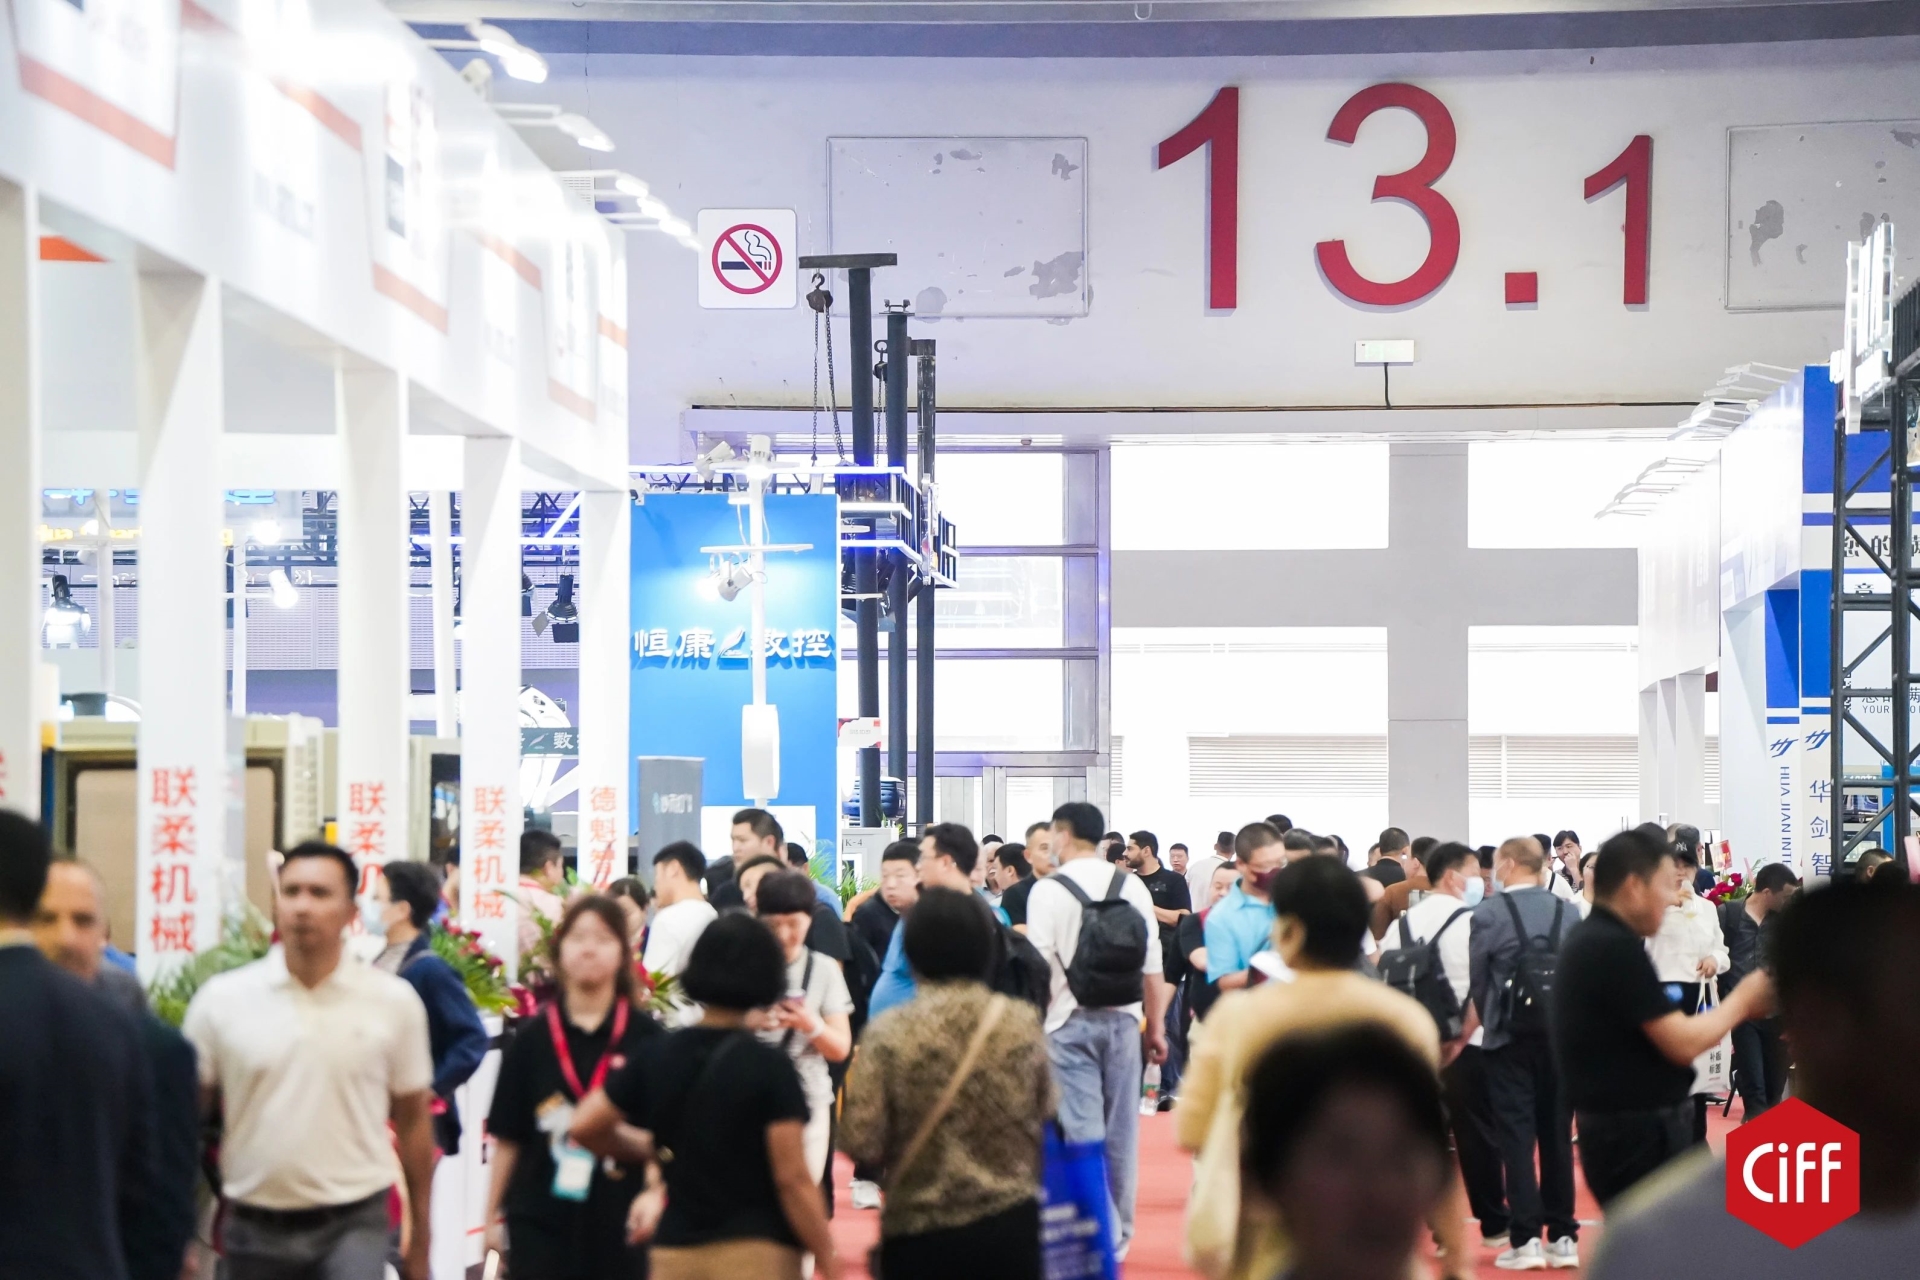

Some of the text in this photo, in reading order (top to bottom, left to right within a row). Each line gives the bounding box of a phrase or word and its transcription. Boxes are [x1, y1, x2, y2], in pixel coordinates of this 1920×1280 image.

[1157, 82, 1652, 309] 13.1
[634, 628, 717, 659] 恒康
[1862, 705, 1890, 714] YOUR
[1780, 766, 1791, 797] HUA
[151, 766, 197, 952] 联柔机械
[474, 785, 506, 919] 联柔机械
